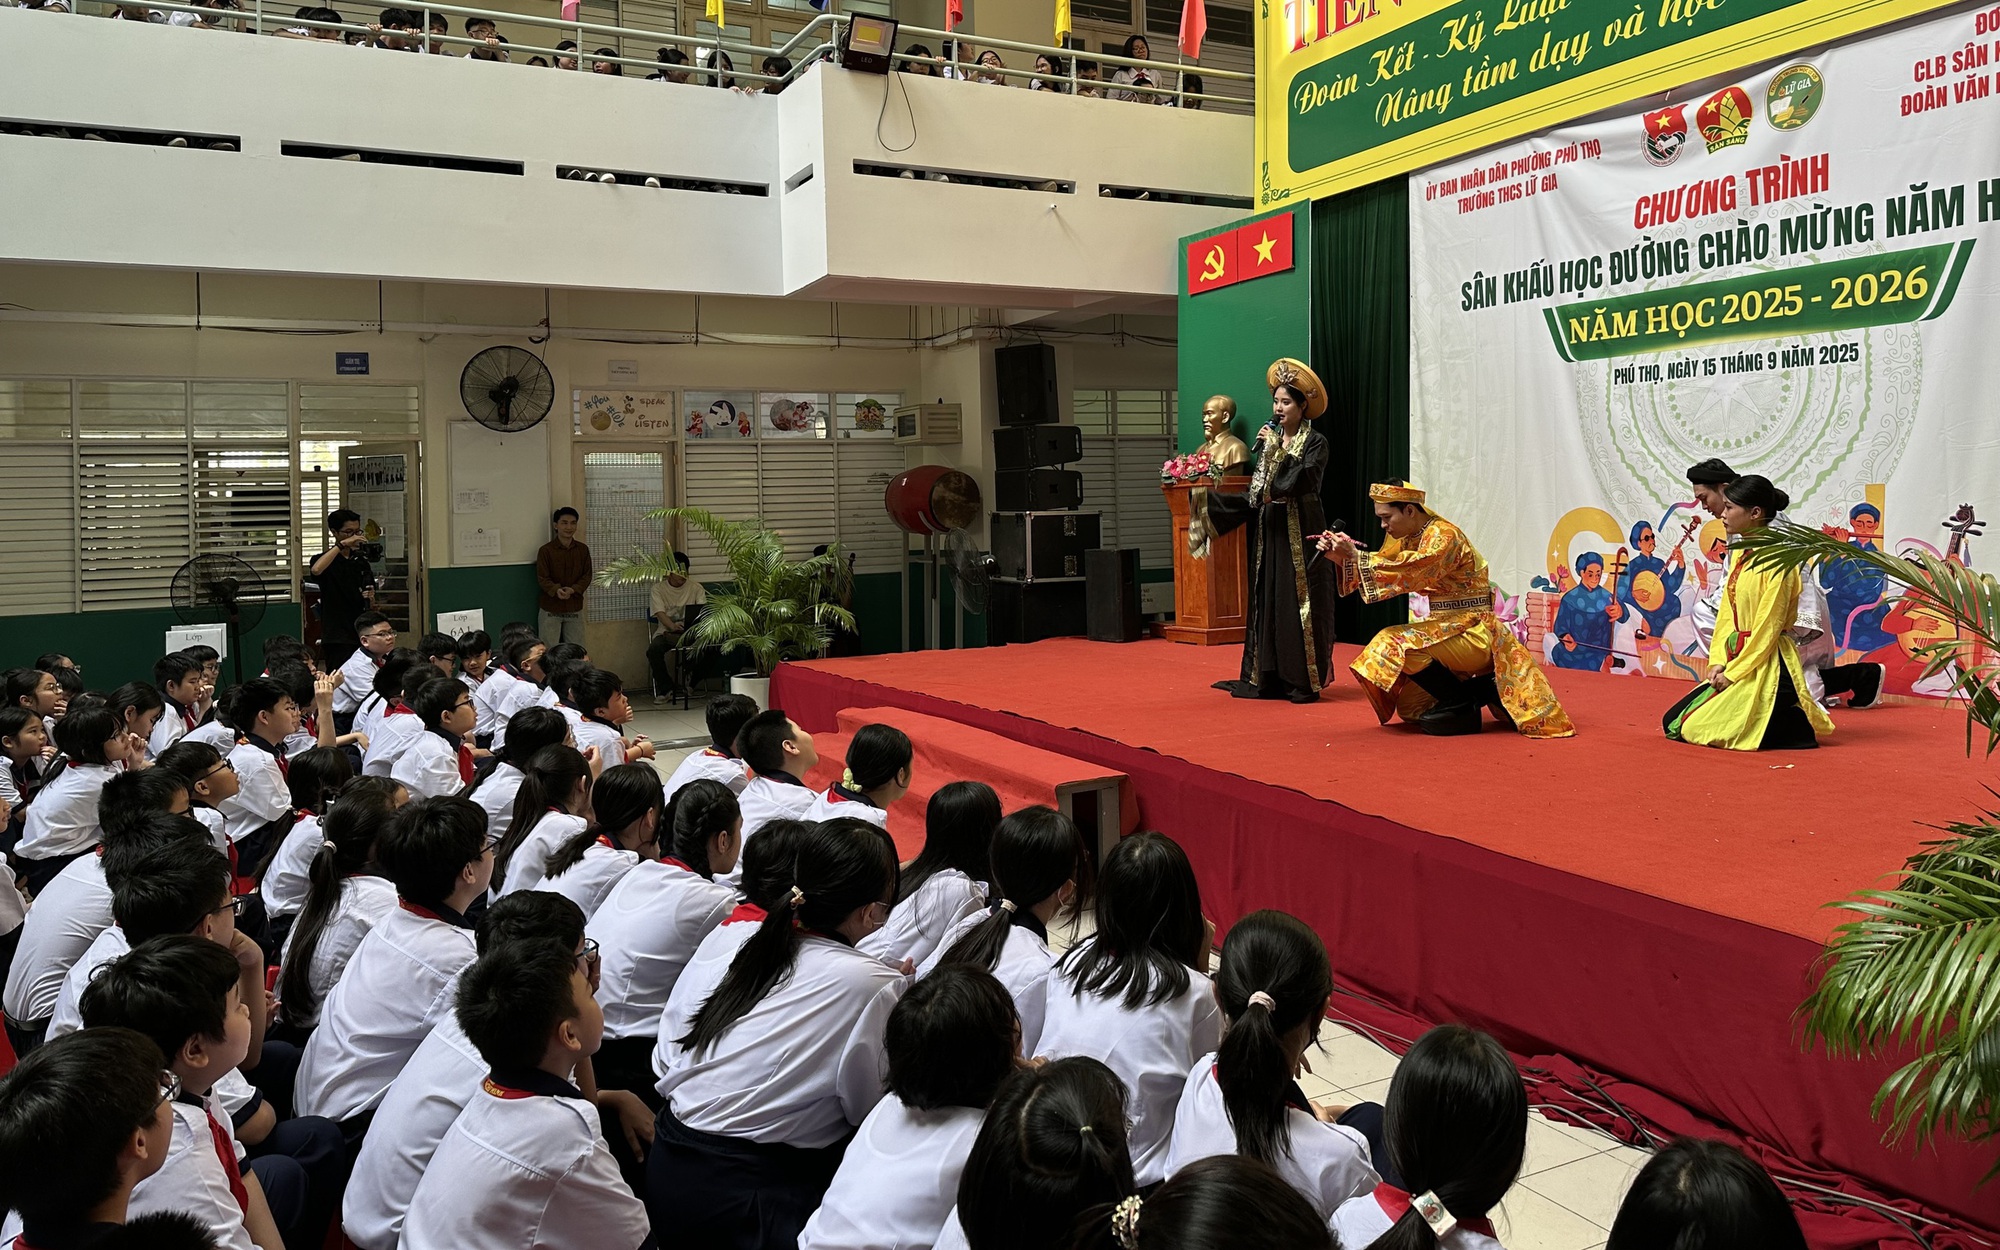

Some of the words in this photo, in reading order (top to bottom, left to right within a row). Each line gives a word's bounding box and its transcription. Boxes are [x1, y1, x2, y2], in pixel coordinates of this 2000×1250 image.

[1285, 0, 1402, 53] TI
[1294, 73, 1360, 114] Đoàn
[1366, 41, 1415, 86] Kết
[1436, 10, 1486, 58] Kỷ
[1375, 82, 1454, 127] Nâng
[1462, 55, 1520, 97] tầm
[1529, 31, 1592, 71] dạy
[1603, 4, 1647, 47] và
[1797, 78, 1811, 90] GIA
[1914, 56, 1946, 82] CLB
[1952, 42, 1988, 72] SÂN
[1901, 85, 1947, 116] ĐOÀN
[1954, 73, 1989, 104] VĂN
[1426, 181, 1437, 201] ỦY
[1440, 178, 1457, 197] BAN
[1460, 168, 1486, 192] NHÂN
[1489, 162, 1508, 184] DÂN
[1511, 151, 1552, 177] PHƯỜNG
[1554, 142, 1578, 165] PHÚ
[1580, 138, 1602, 159] THỌ
[1458, 190, 1494, 214] TRƯỜNG
[1498, 183, 1522, 204] THCS
[1526, 175, 1538, 197] LỮ
[1541, 173, 1558, 192] GIA
[1634, 175, 1736, 230] CHƯƠNG
[1746, 153, 1829, 207] TRÌNH
[1461, 272, 1497, 312] SÂN
[1503, 258, 1554, 304] KHẤU
[1560, 256, 1602, 298] HỌC
[1609, 236, 1689, 286] ĐƯỜNG
[1698, 219, 1770, 269] CHÀO
[1780, 203, 1874, 256] MỪNG
[1886, 182, 1964, 238] NĂM
[1569, 308, 1637, 344] NĂM
[1645, 298, 1715, 338] HỌC
[1722, 284, 1803, 324] 2025
[1831, 265, 1928, 309] 2026
[1614, 363, 1635, 385] PHÚ
[1639, 365, 1664, 385] THỌ,
[1667, 357, 1698, 380] NGÀY
[1703, 358, 1716, 376] 15
[1721, 351, 1763, 374] THÁNG
[1768, 351, 1776, 370] 9
[1782, 345, 1814, 368] NĂM
[1819, 343, 1859, 364] 2025
